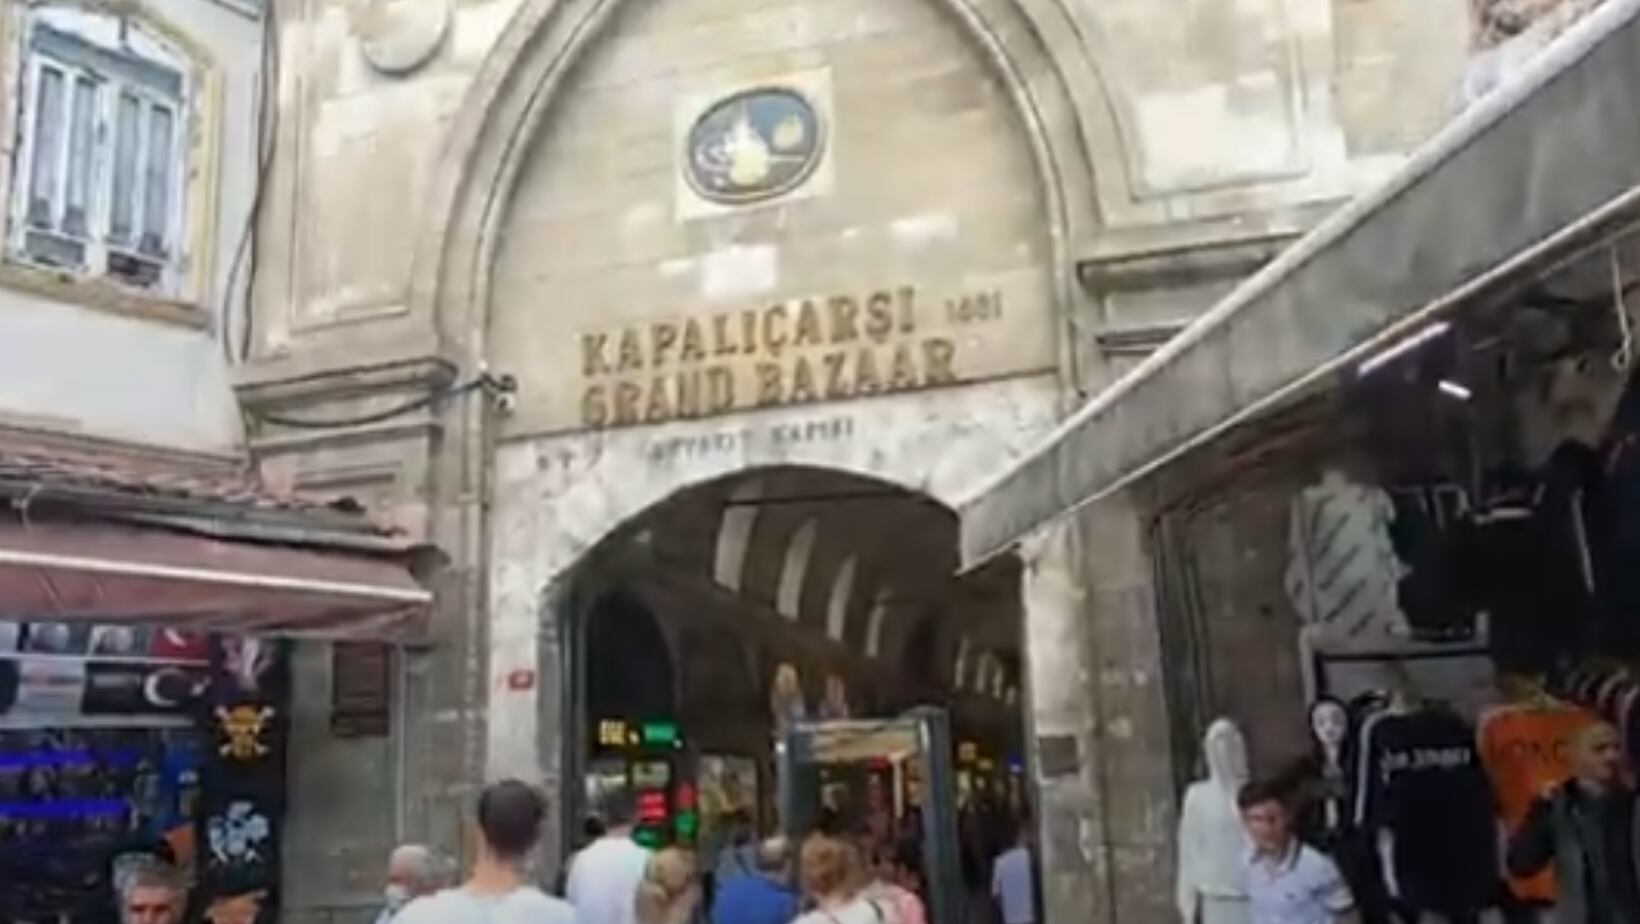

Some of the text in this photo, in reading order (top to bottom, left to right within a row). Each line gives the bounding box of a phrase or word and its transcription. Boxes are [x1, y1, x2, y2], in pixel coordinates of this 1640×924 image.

[581, 286, 917, 378] KAPALIÇARŞI
[581, 337, 957, 430] GRAND BAZAAR
